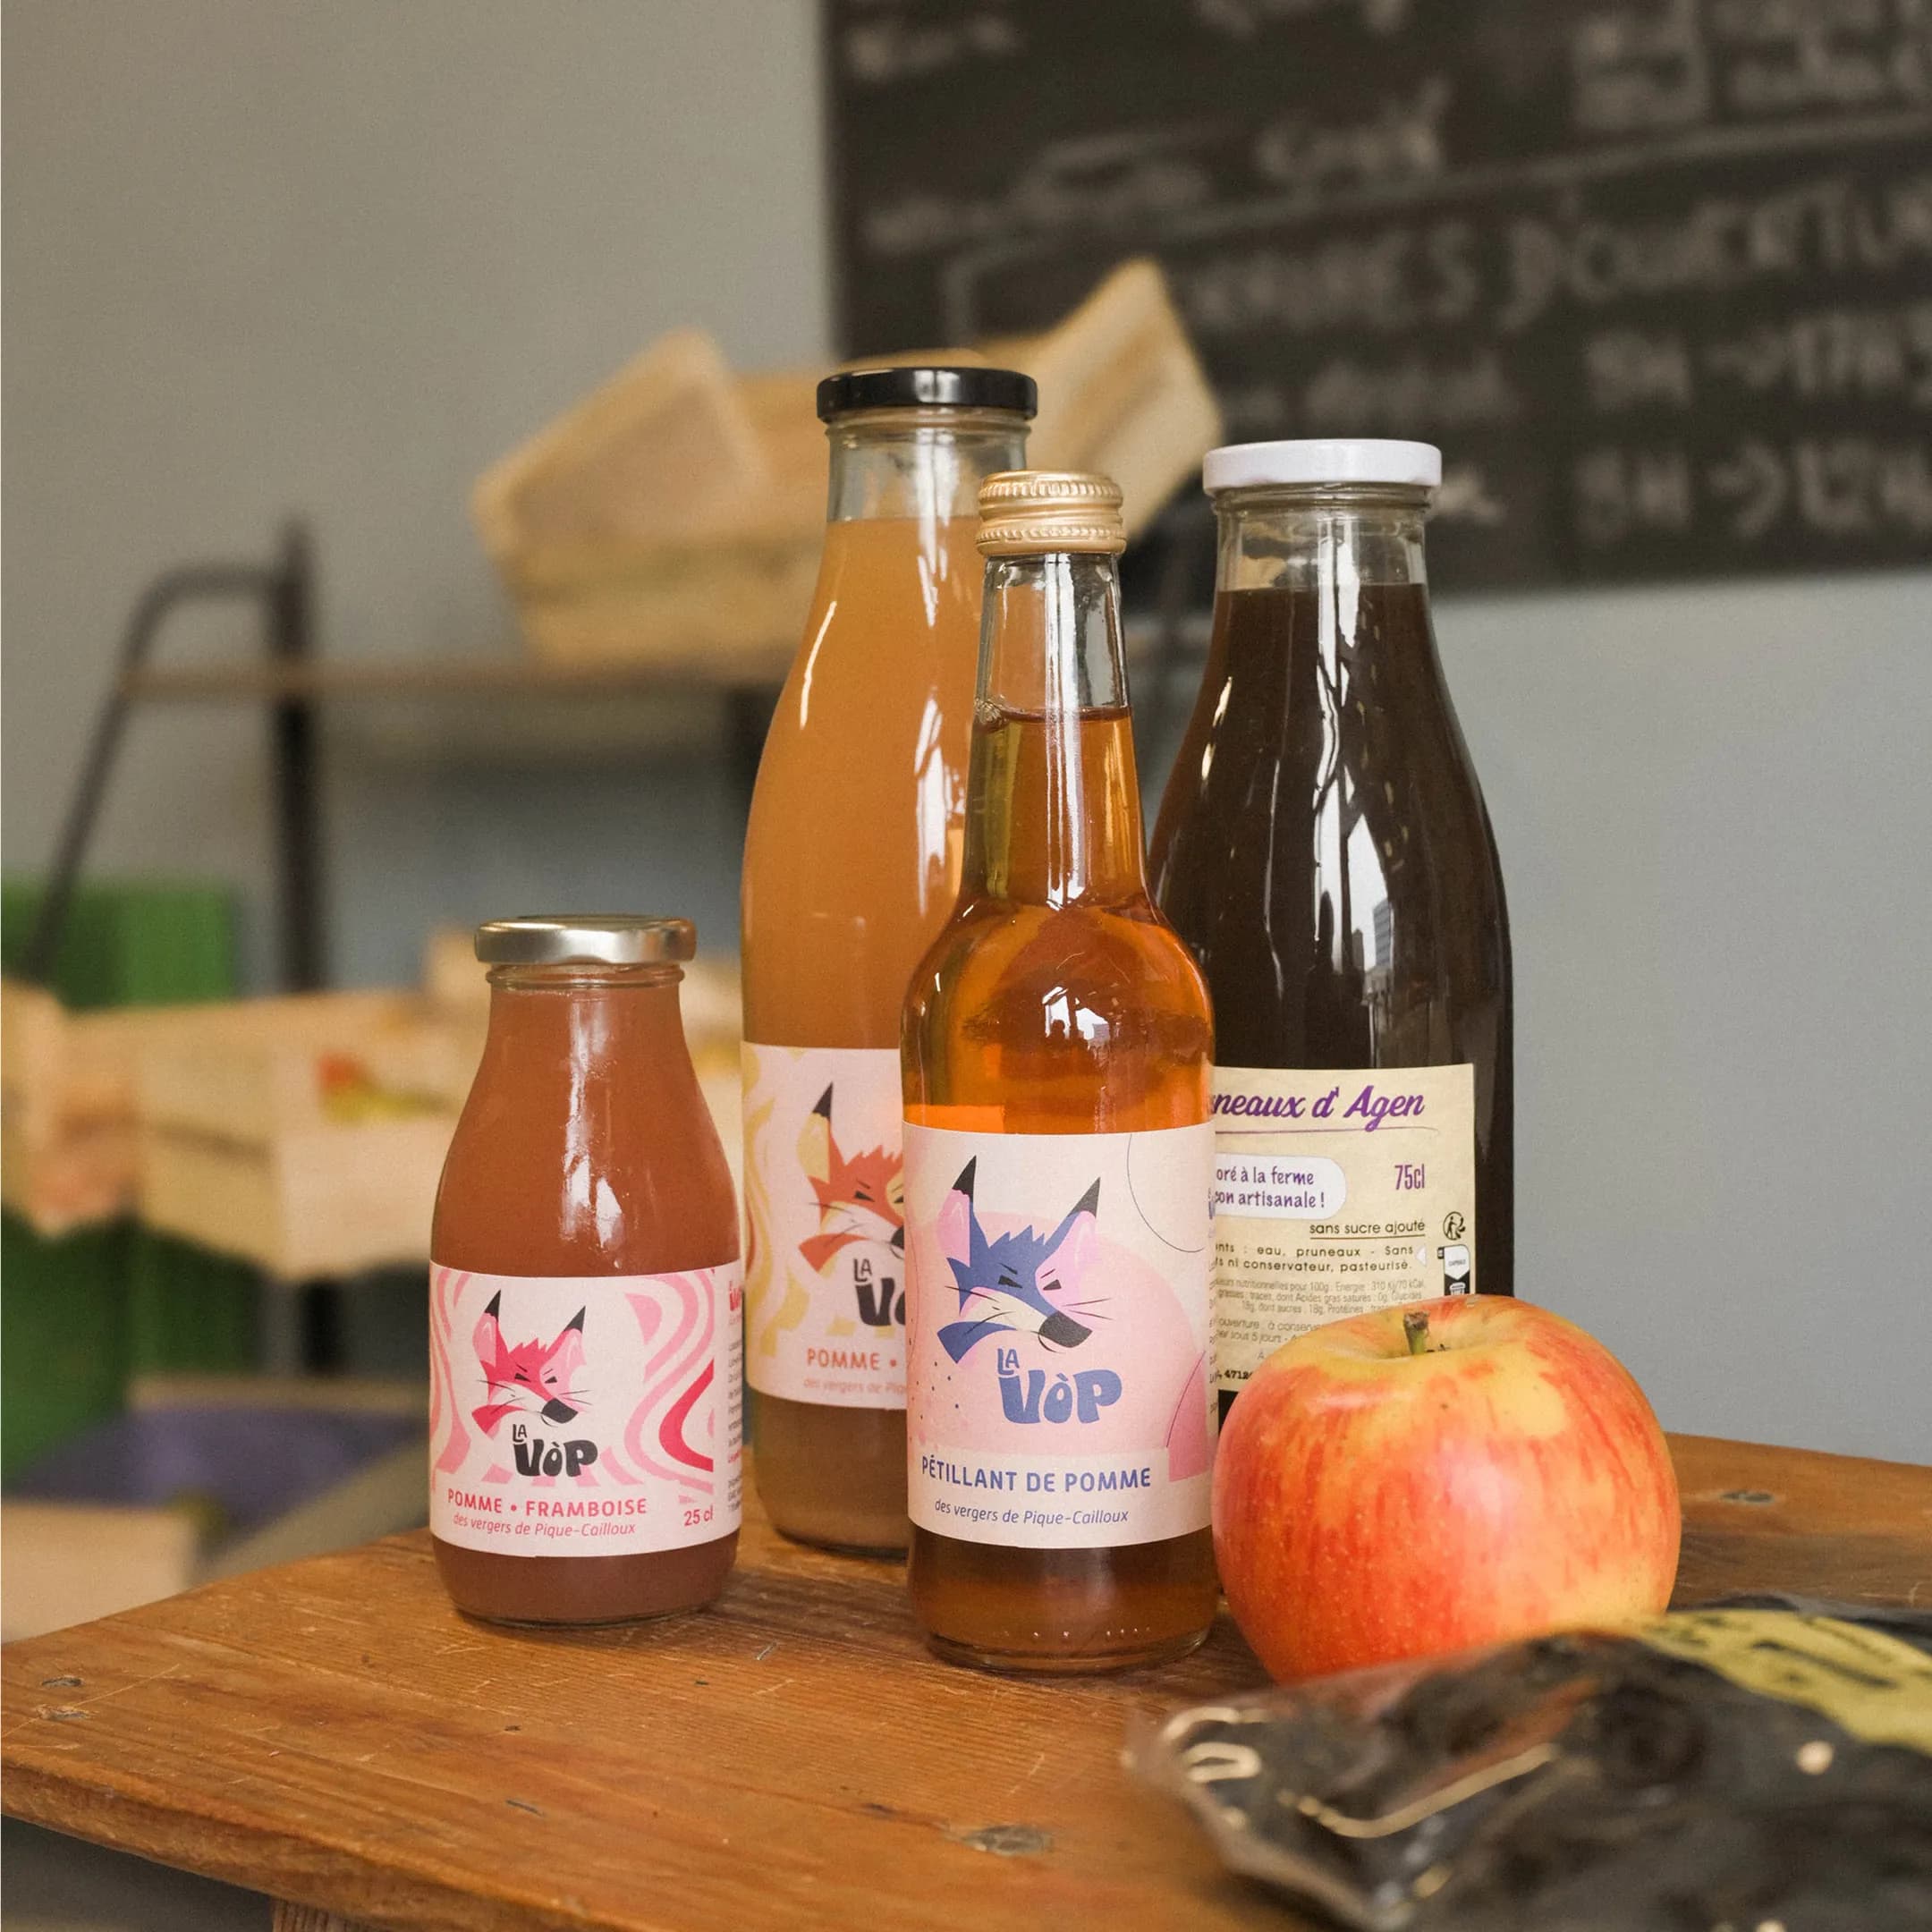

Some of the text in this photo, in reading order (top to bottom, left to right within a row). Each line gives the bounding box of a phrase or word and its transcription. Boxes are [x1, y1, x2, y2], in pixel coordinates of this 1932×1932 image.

[1211, 1085, 1426, 1132] neaux d' Agen
[1241, 1165, 1249, 1182] à
[1253, 1166, 1267, 1184] la
[1271, 1165, 1315, 1185] ferme
[1394, 1164, 1426, 1191] 75cl
[1238, 1191, 1317, 1208] artisanale
[1309, 1219, 1426, 1237] sans sucre ajouté
[1215, 1242, 1234, 1253] nts
[1296, 1246, 1360, 1258] pruneaux
[1385, 1244, 1413, 1256] Sans
[853, 1257, 873, 1283] LA
[1228, 1257, 1239, 1267] ni
[1243, 1258, 1334, 1273] conservateur,
[807, 1347, 880, 1371] POMME
[996, 1347, 1020, 1376] LA
[513, 1423, 528, 1443] LA
[921, 1453, 1151, 1493] PÉTILLANT DE POMME
[447, 1487, 648, 1518] POMME FRAMBOISE
[934, 1498, 1129, 1528] des vergers de Pique-Cailloux
[453, 1512, 636, 1539] des vergers de Pique-Cailloux
[683, 1503, 714, 1528] 25 cl
